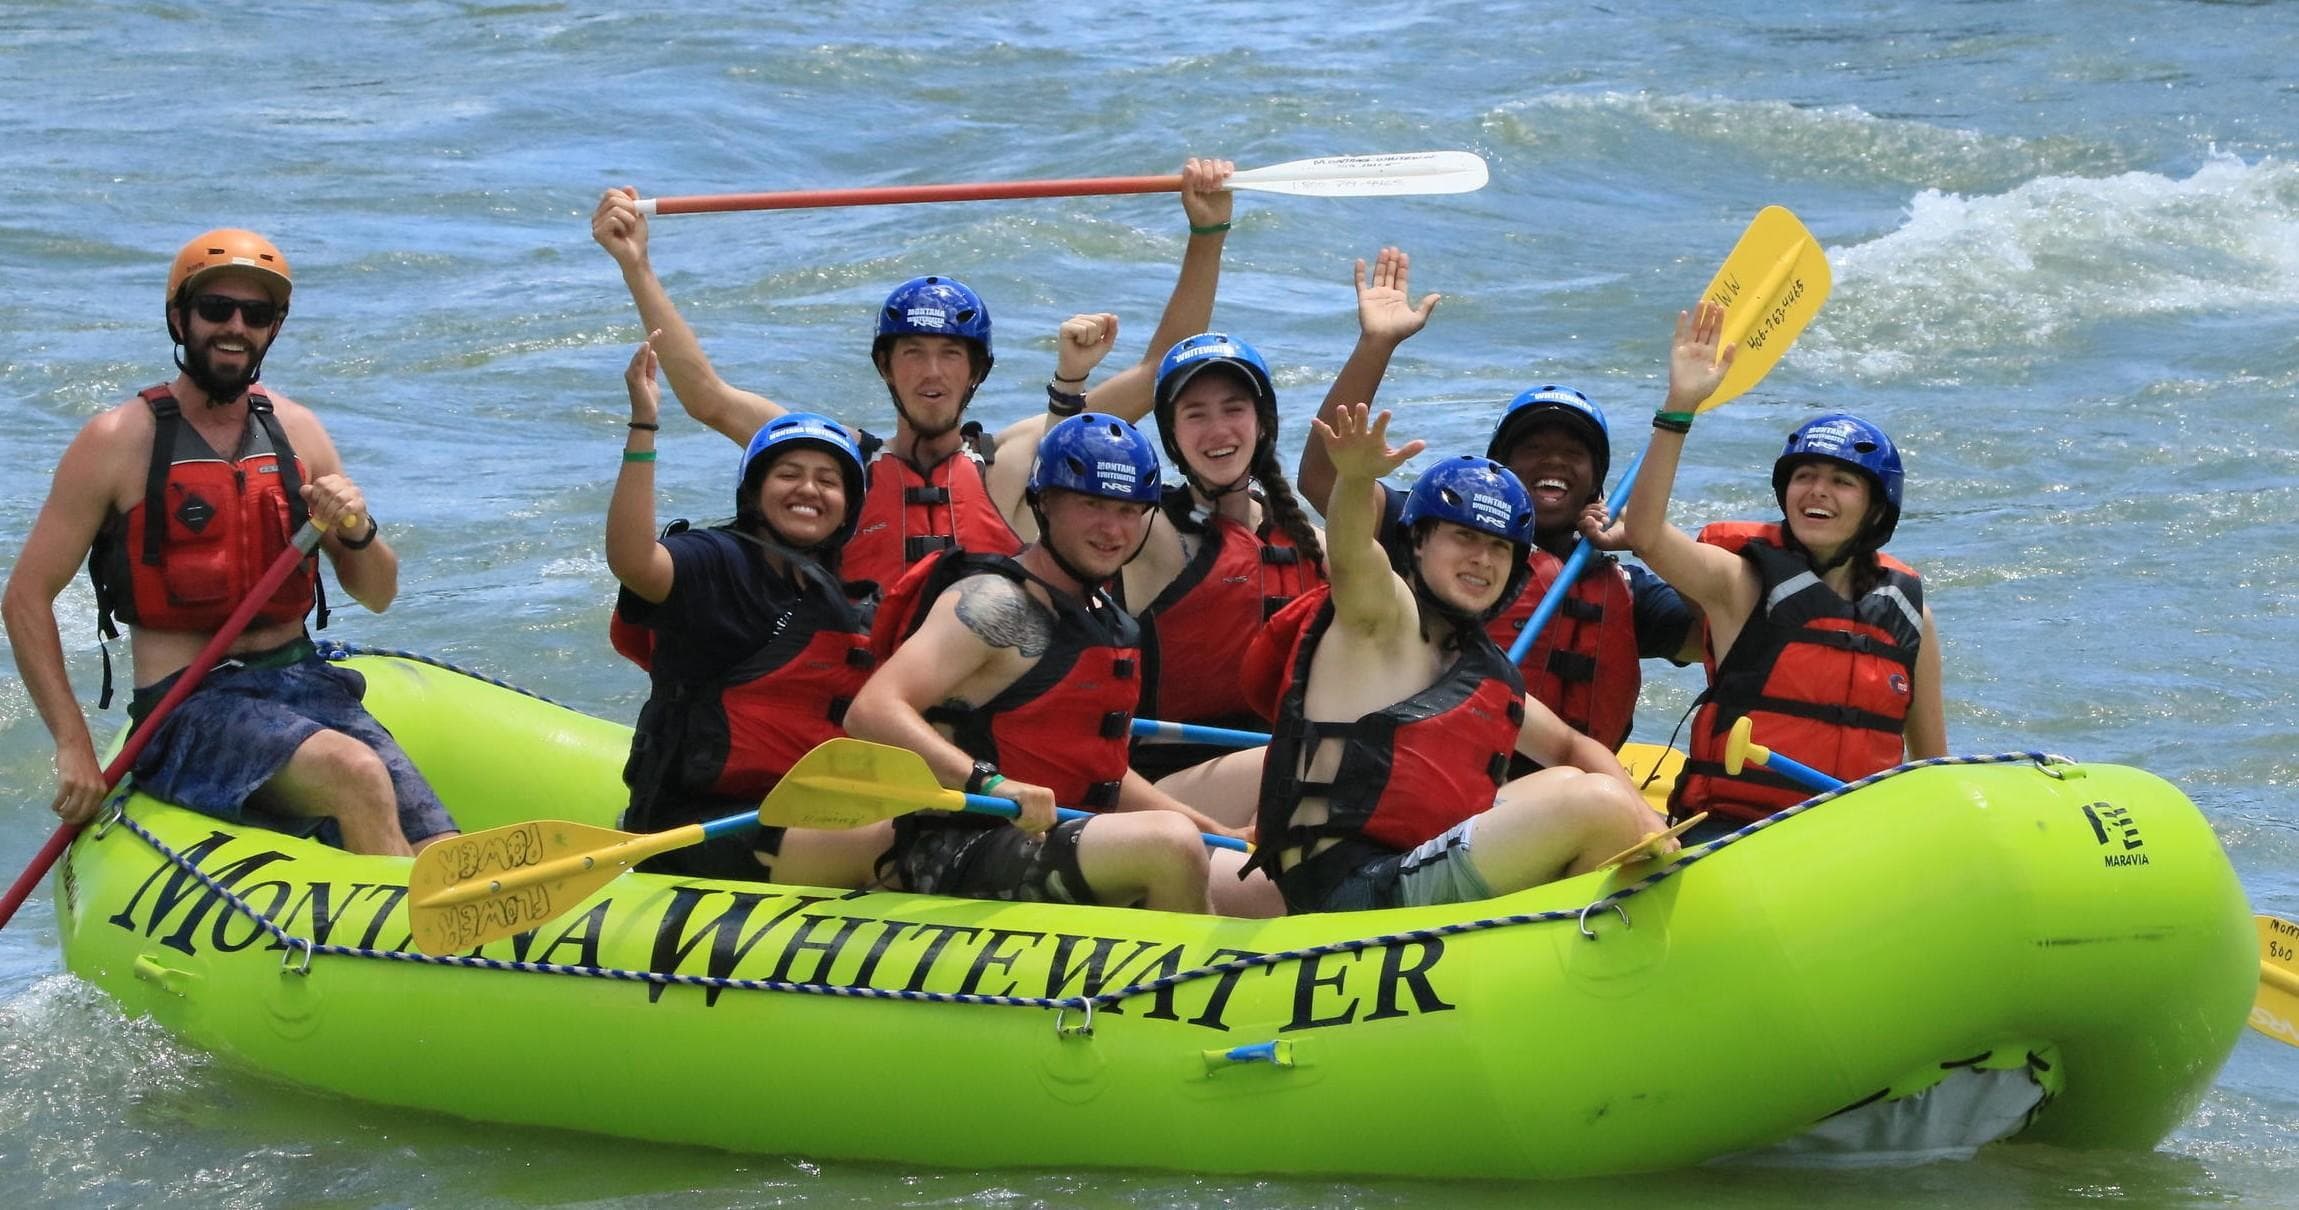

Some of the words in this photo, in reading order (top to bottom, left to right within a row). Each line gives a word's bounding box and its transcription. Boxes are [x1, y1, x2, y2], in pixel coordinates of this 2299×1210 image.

[1747, 278, 1805, 350] 406-763-4465
[1097, 461, 1136, 475] MONTANA
[1102, 481, 1132, 493] NRS
[1473, 493, 1512, 514] MONTANA
[1476, 513, 1506, 528] NRS
[439, 823, 544, 886] POWER
[2104, 853, 2150, 868] MARAVIA
[439, 883, 551, 951] FLOWER
[108, 830, 612, 969] MONTA
[648, 886, 1456, 1034] WHITEWATER
[2269, 941, 2293, 961] 800
